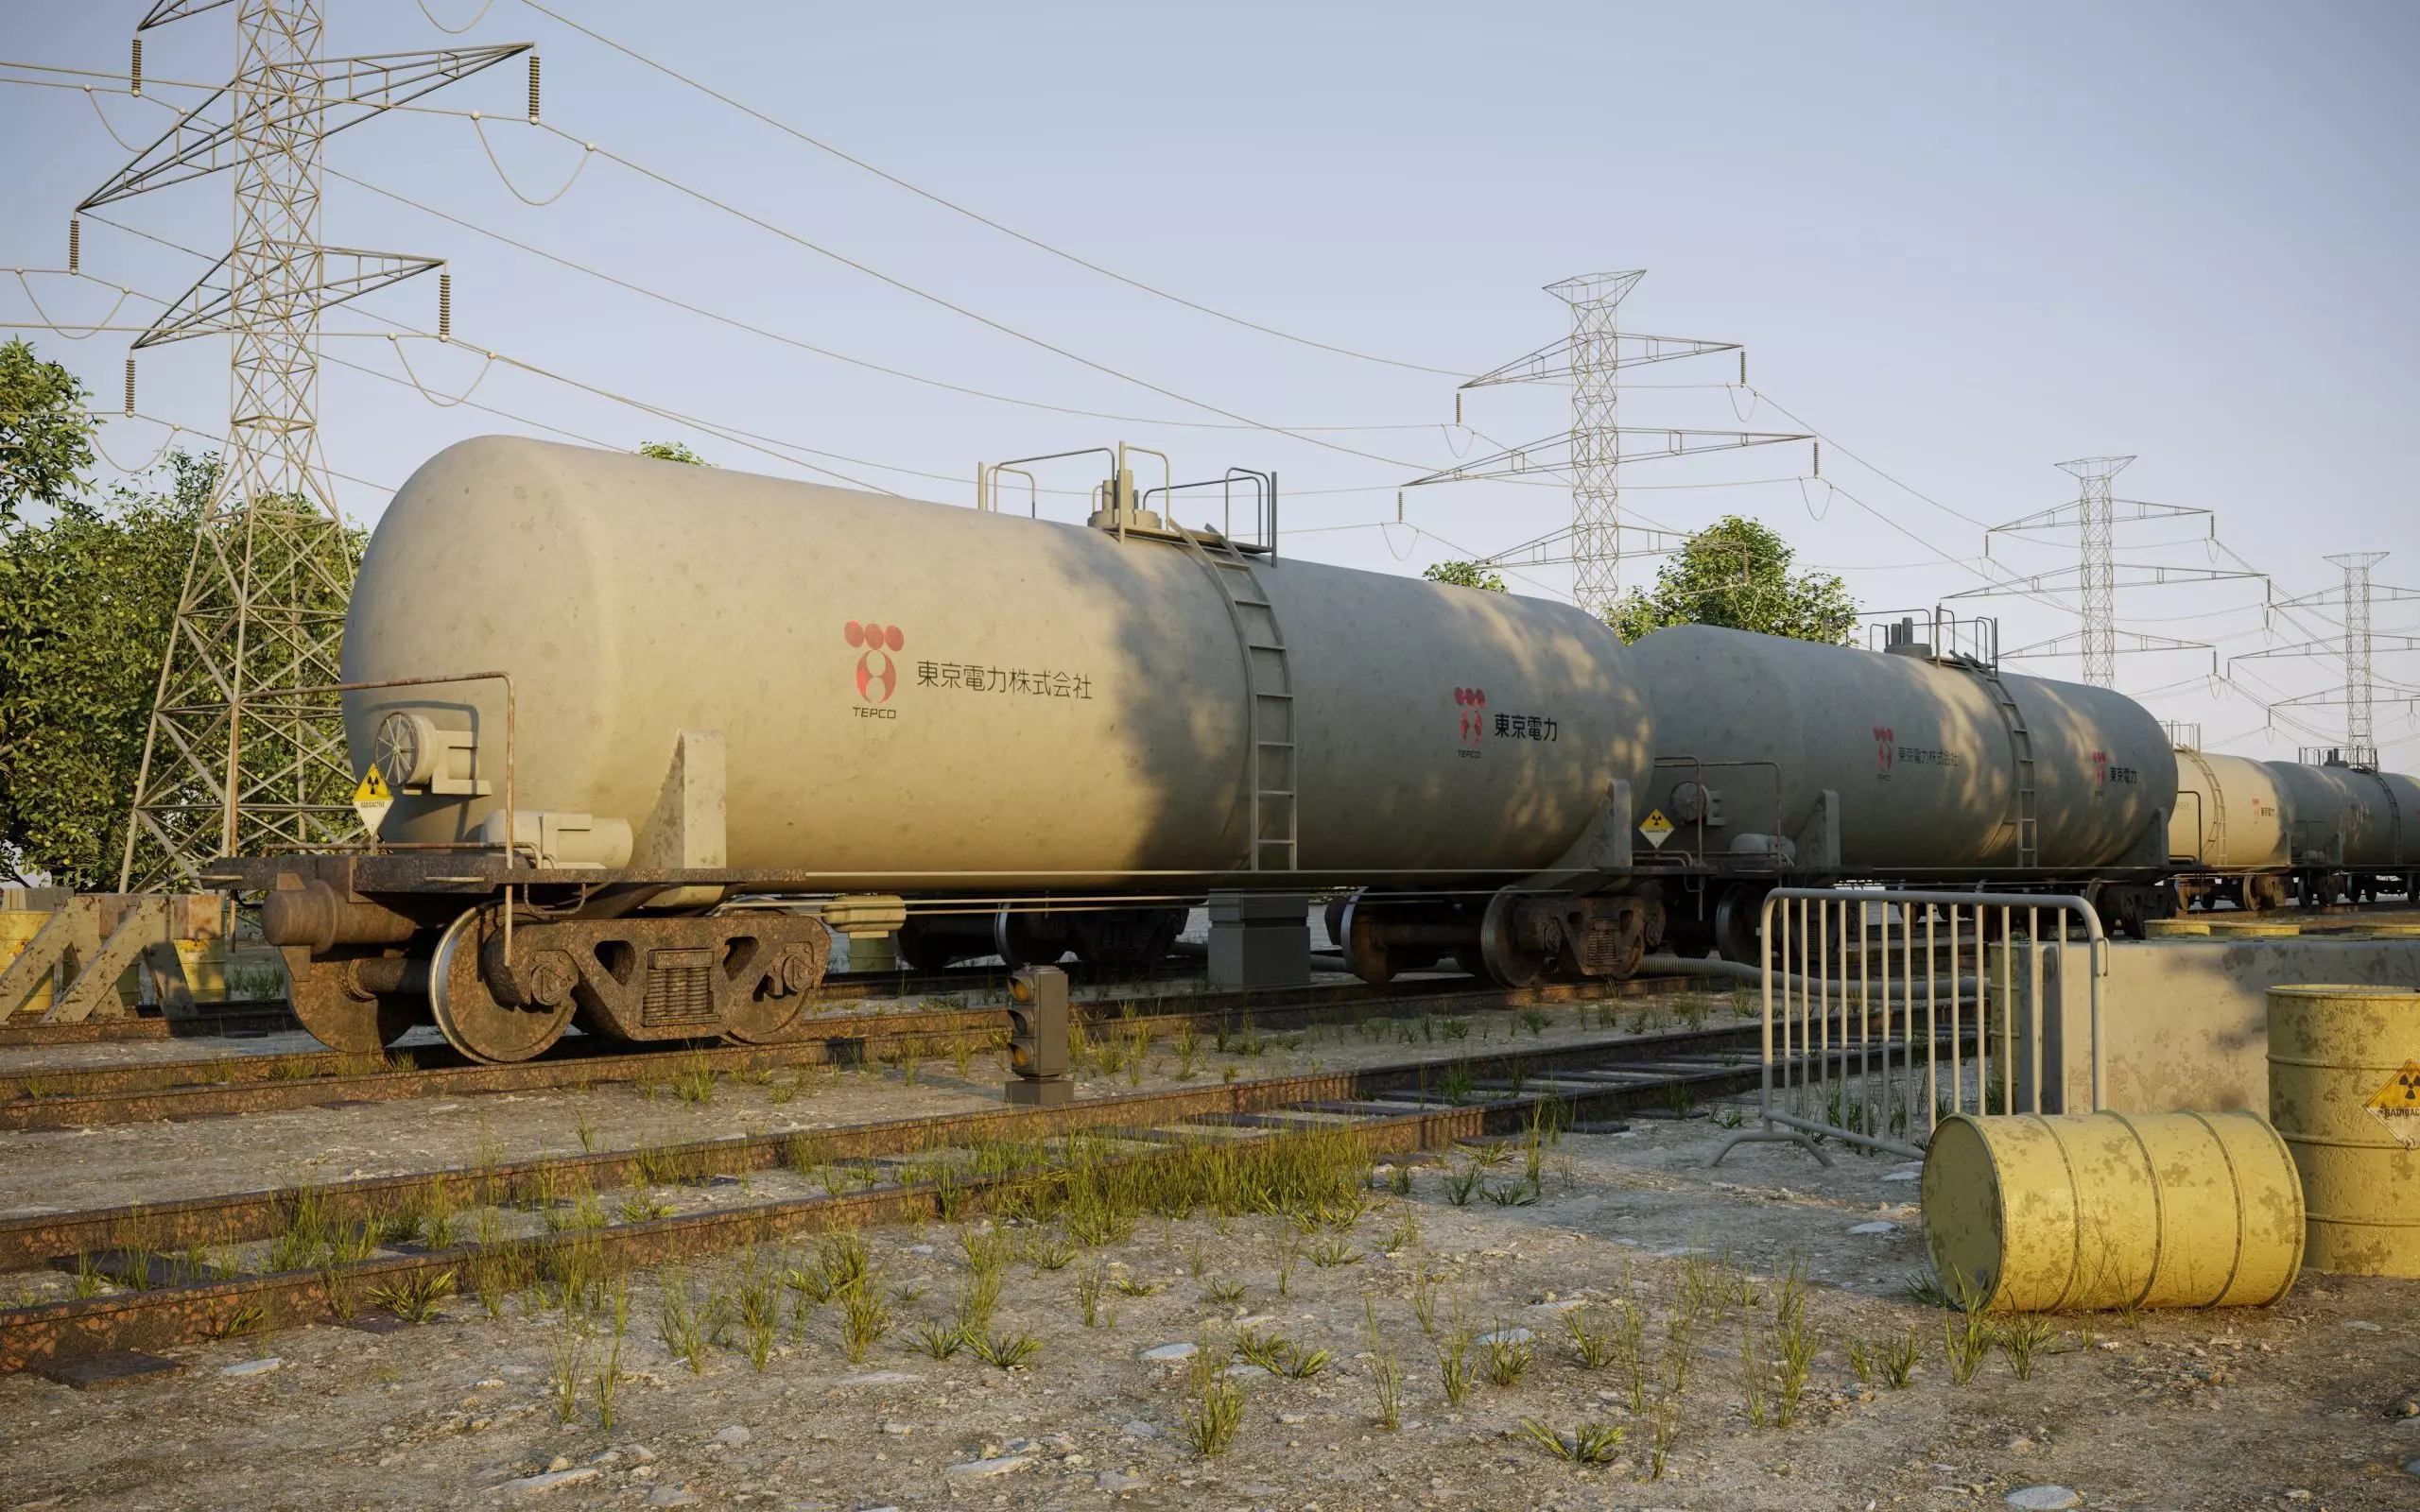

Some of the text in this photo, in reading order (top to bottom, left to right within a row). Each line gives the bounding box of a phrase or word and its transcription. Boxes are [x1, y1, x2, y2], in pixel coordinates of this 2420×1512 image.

[916, 660, 1093, 699] 東京電力株式会社
[853, 706, 896, 719] TEPCO
[1494, 713, 1558, 742] 東京電力
